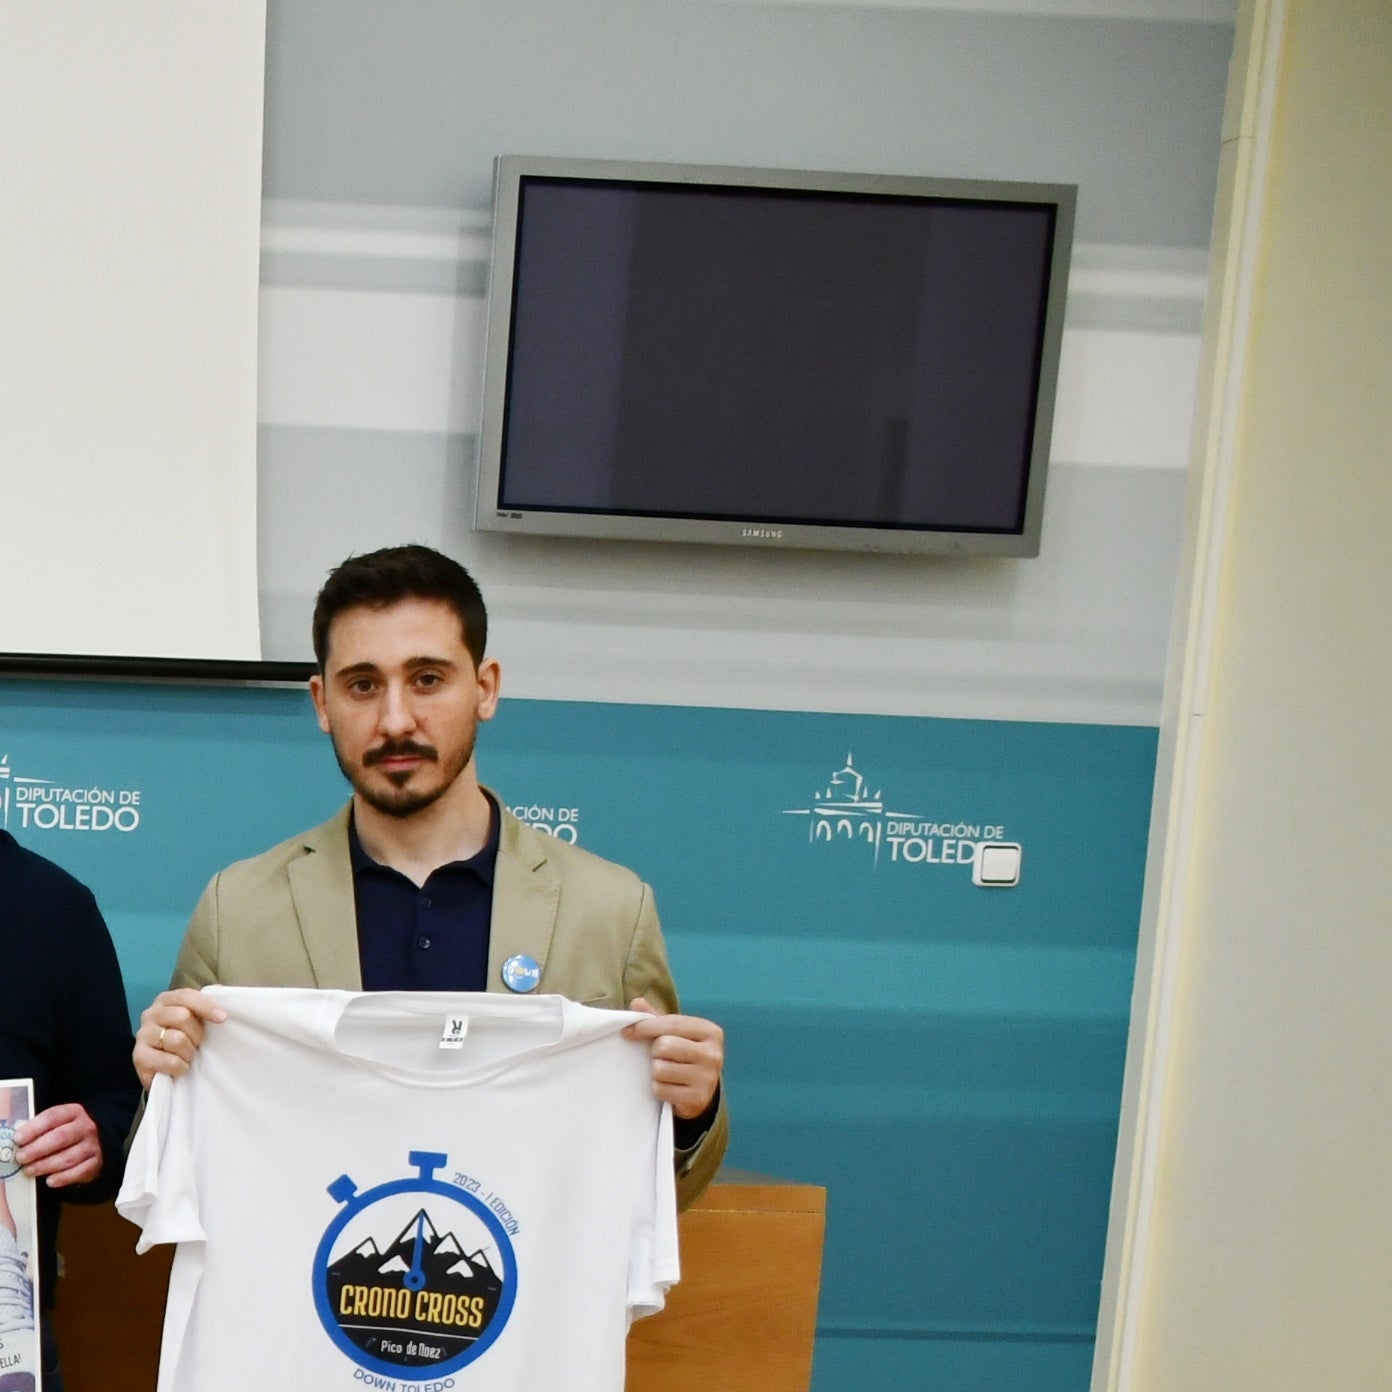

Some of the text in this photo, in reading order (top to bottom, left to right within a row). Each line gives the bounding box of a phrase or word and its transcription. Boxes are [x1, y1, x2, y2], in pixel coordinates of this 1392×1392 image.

[742, 528, 784, 539] SAMSUNG
[16, 786, 141, 805] DIPUTACIÓN DE
[16, 803, 140, 832] TOLEDO
[558, 808, 579, 822] DE
[886, 822, 1005, 839] DIPUTACIÓN DE
[886, 837, 976, 864] TOLED
[452, 1172, 482, 1194] 2023
[339, 1284, 484, 1328] CRONO CROSS
[381, 1339, 403, 1354] Pico
[406, 1340, 417, 1355] de
[0, 1353, 22, 1369] ELLA!
[352, 1367, 396, 1392] DOWN
